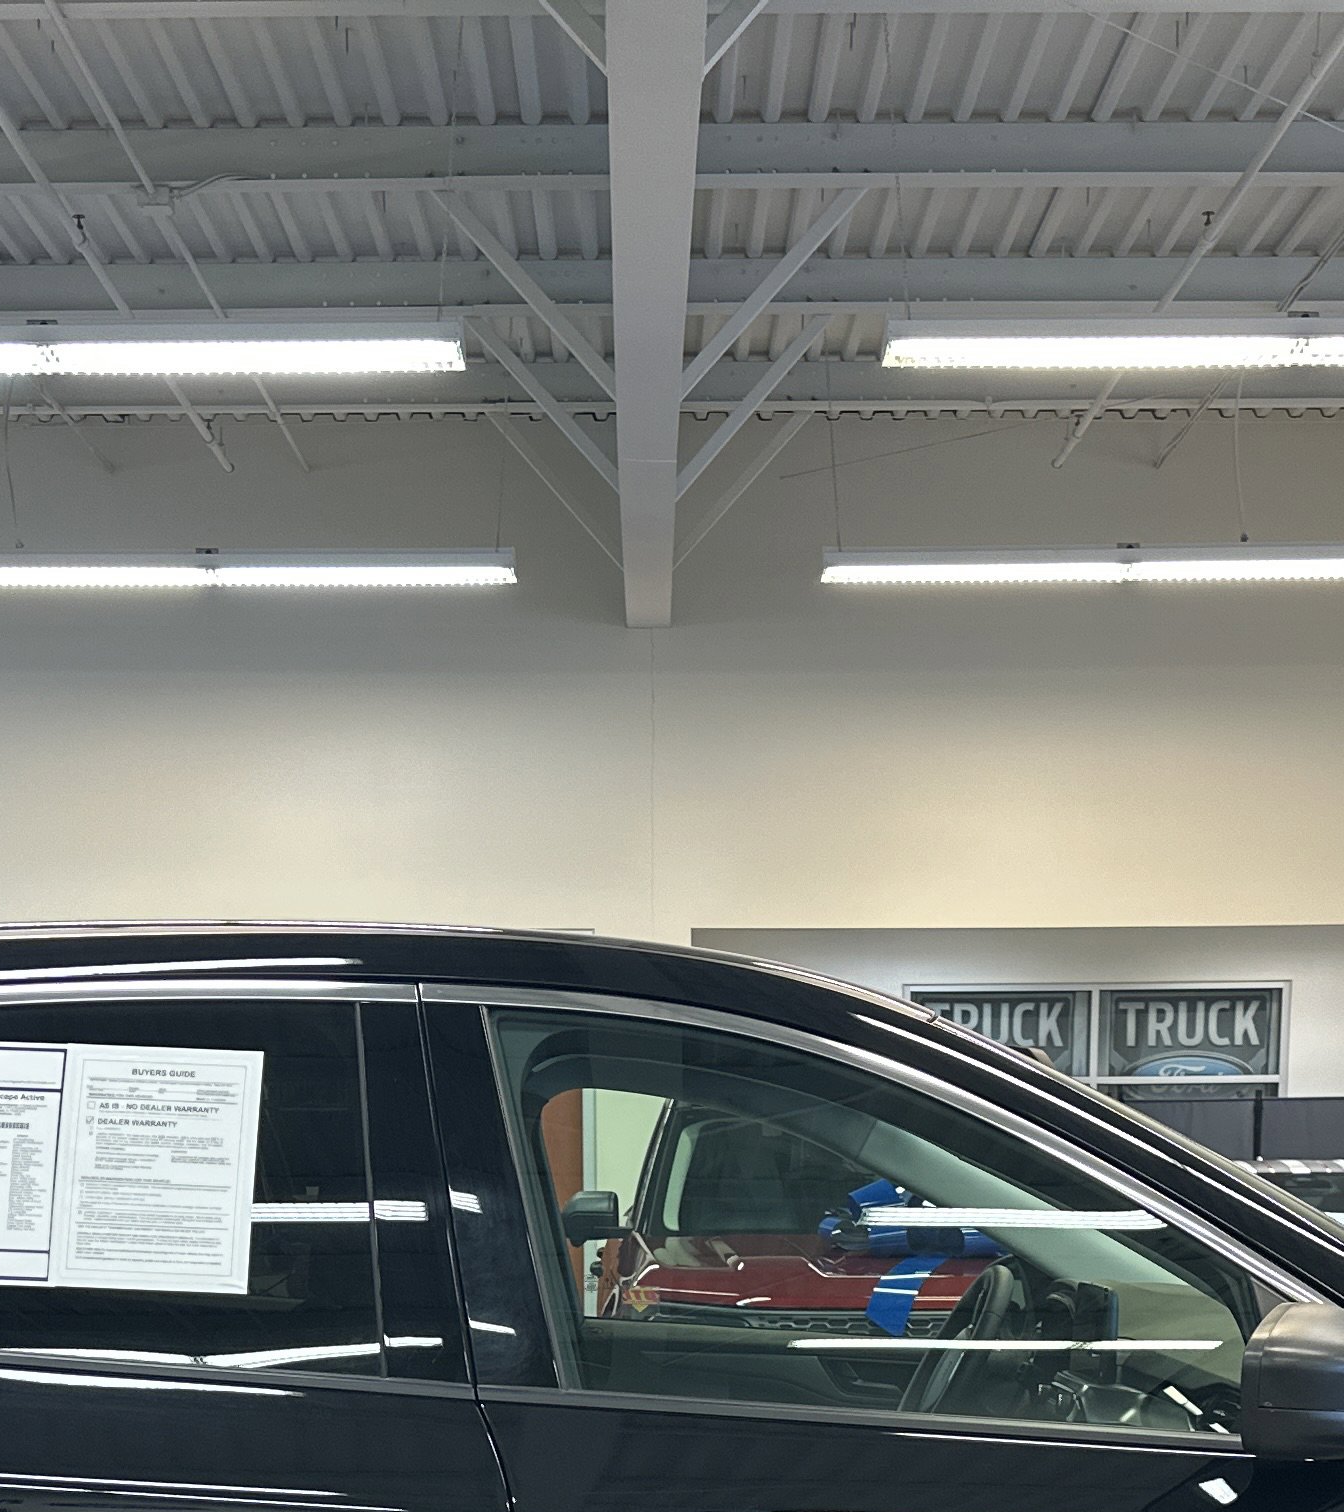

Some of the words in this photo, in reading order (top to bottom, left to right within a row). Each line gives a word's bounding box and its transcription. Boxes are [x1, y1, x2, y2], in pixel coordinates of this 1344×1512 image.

[1118, 1000, 1261, 1047] TRUCK
[131, 1068, 167, 1077] BUYERS
[168, 1069, 196, 1078] GUIDE
[20, 1093, 45, 1101] Active
[140, 1104, 172, 1112] DEALER
[173, 1105, 220, 1114] WARRANTY
[131, 1119, 178, 1128] WARRANTY
